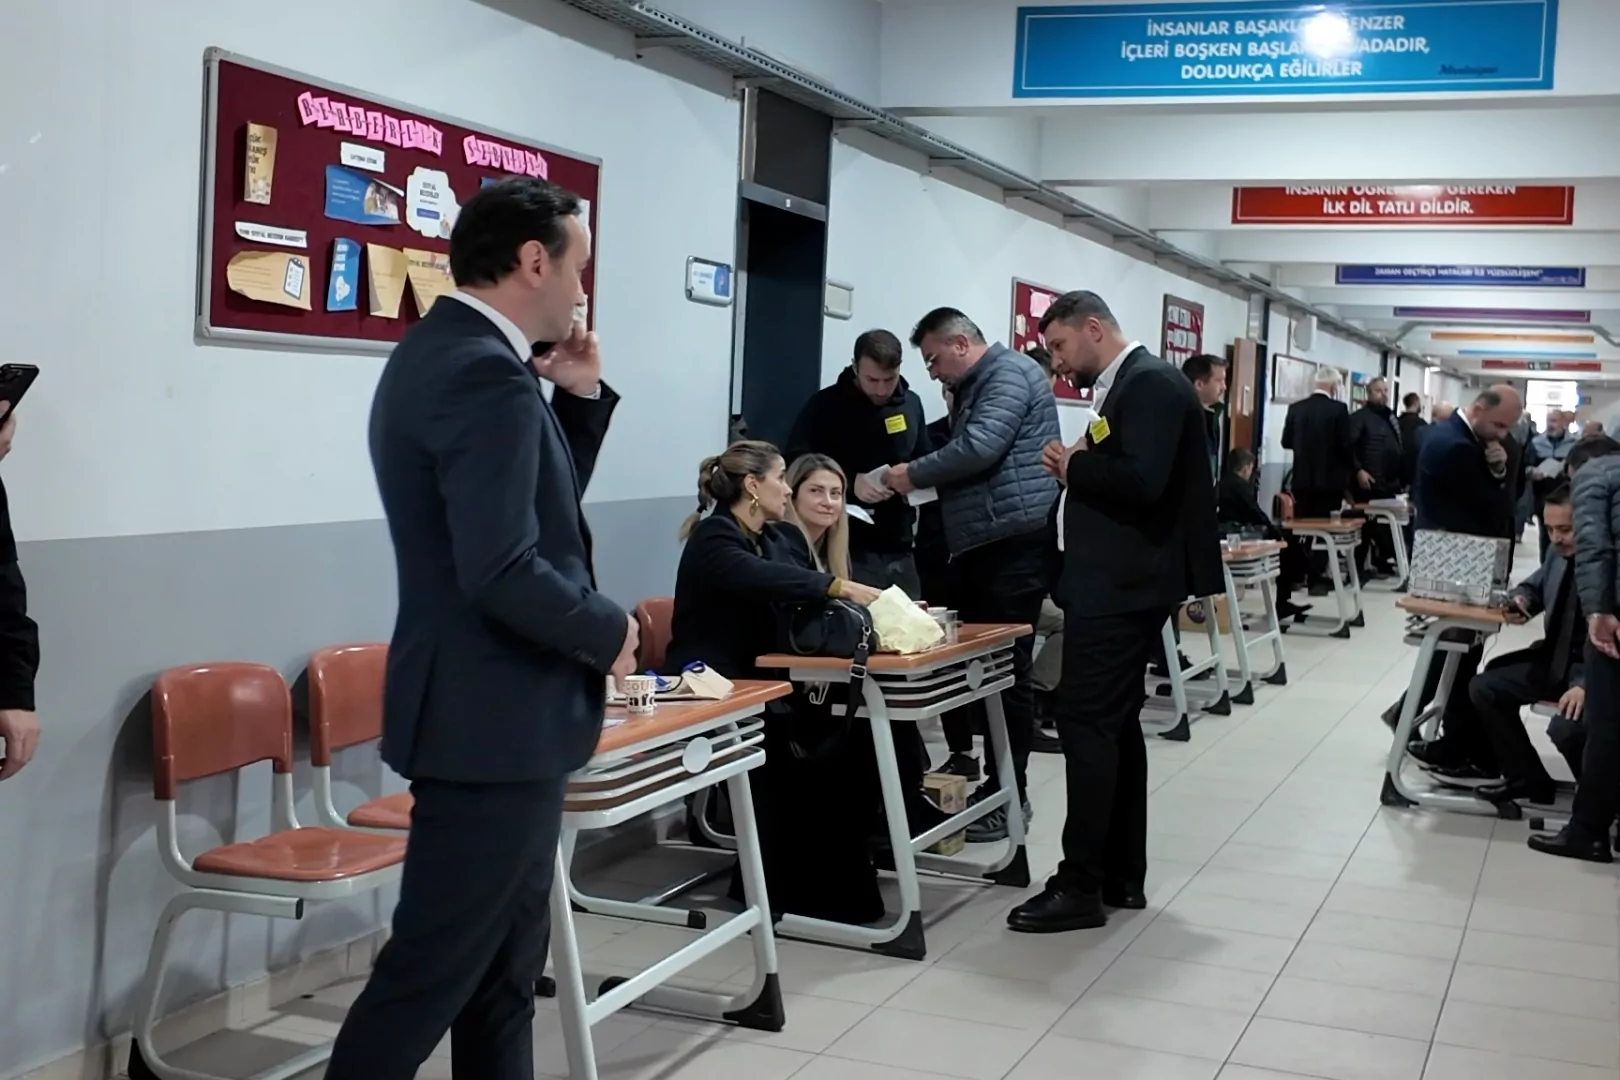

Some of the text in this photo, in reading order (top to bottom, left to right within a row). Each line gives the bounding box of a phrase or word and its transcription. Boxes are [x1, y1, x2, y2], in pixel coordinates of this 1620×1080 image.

[1146, 18, 1230, 37] İNSANLAR
[1341, 15, 1406, 35] ENZER
[1120, 41, 1169, 60] İÇLERİ
[1174, 41, 1243, 60] BOŞKEN
[1180, 59, 1363, 81] DOLDUKÇA EĞİLİRLER
[1322, 197, 1474, 214] İLK DİL TATLI DİLDİR.
